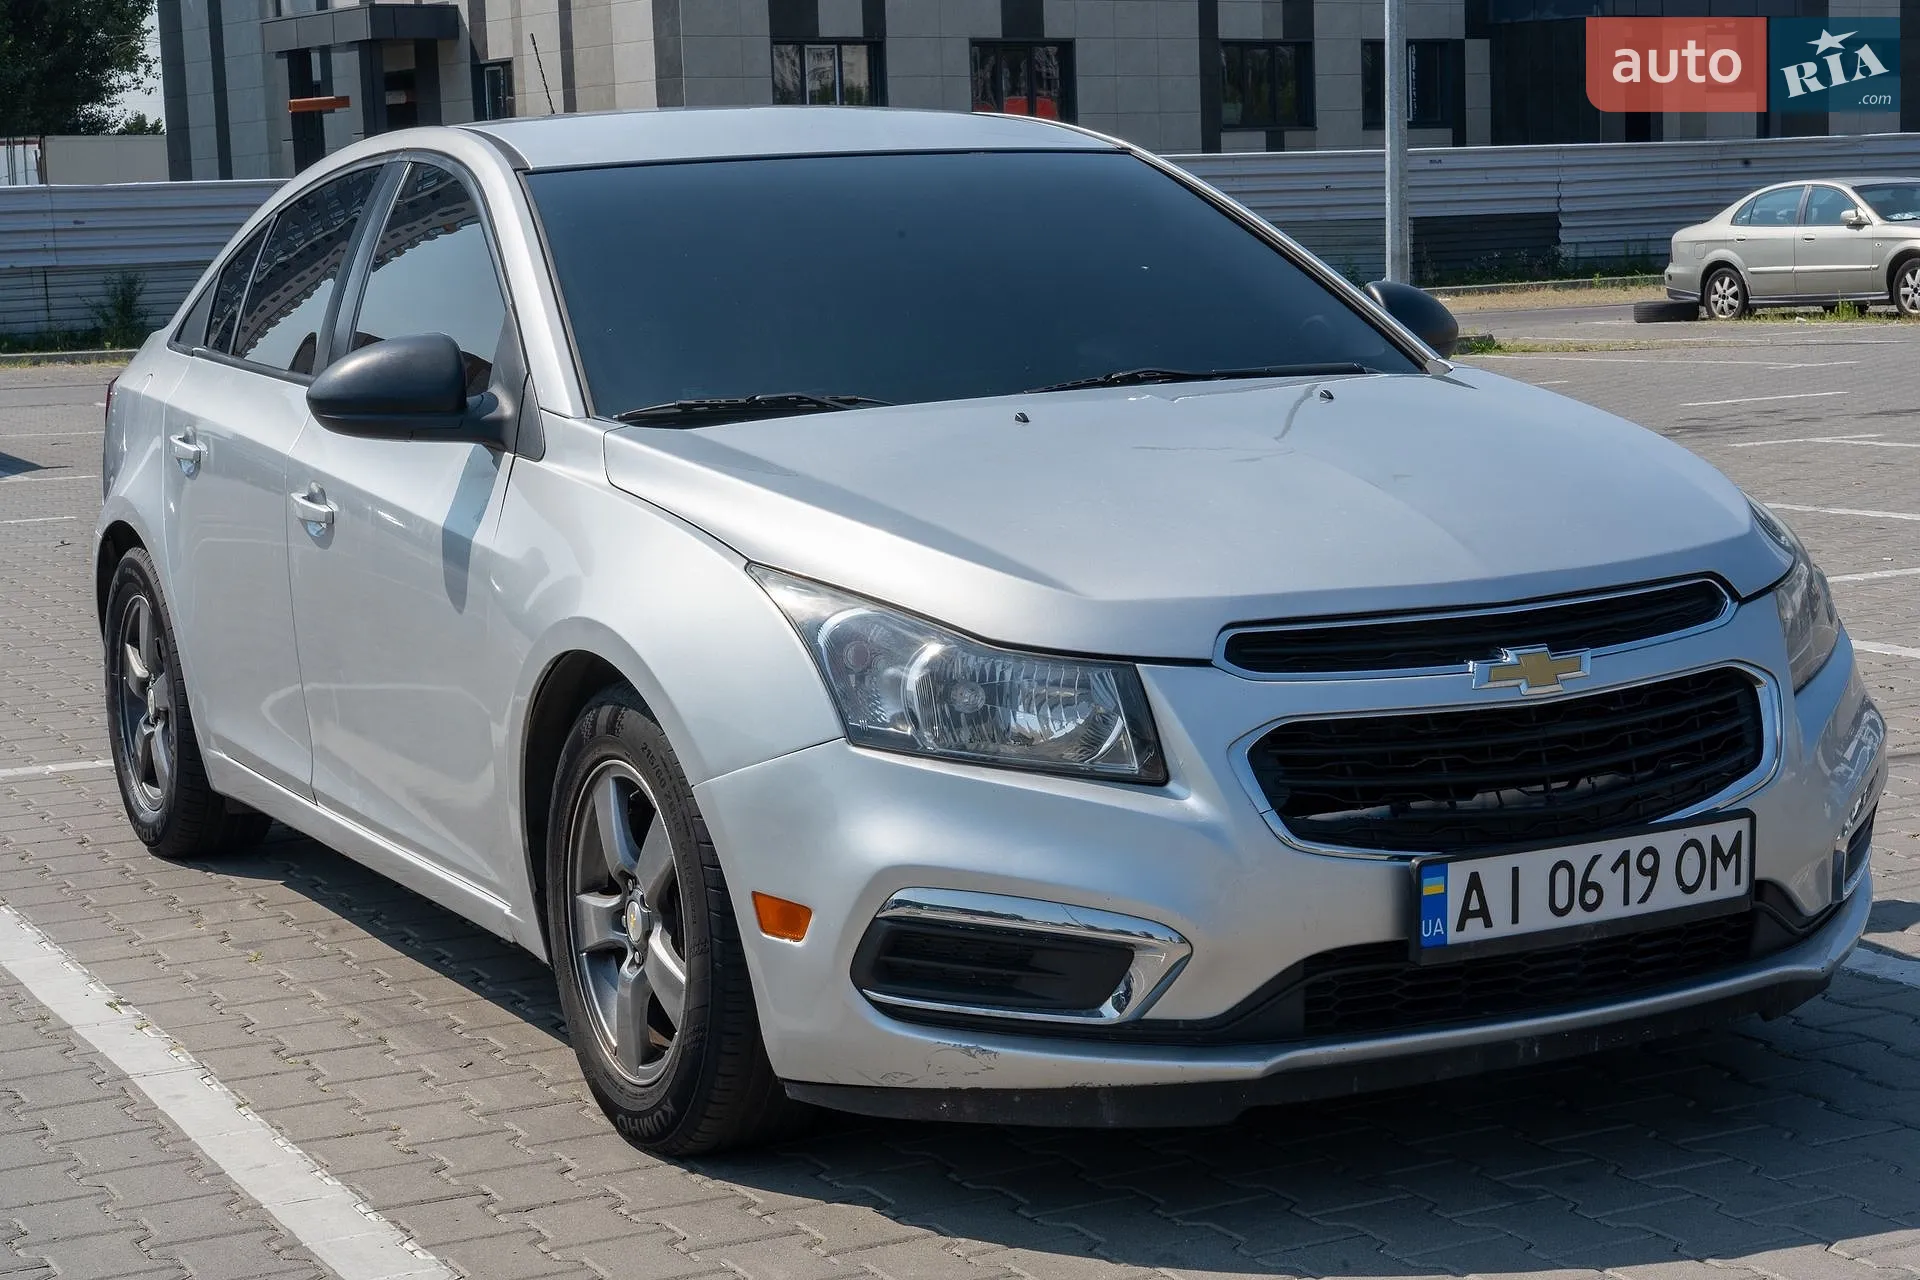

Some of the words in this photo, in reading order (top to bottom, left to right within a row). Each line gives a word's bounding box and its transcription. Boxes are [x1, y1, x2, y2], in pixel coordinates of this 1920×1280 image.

[1455, 866, 1519, 932] AI
[1548, 845, 1660, 917] 0619
[1675, 830, 1743, 895] OM
[1422, 918, 1444, 937] UA
[617, 1097, 677, 1137] KUMHO
